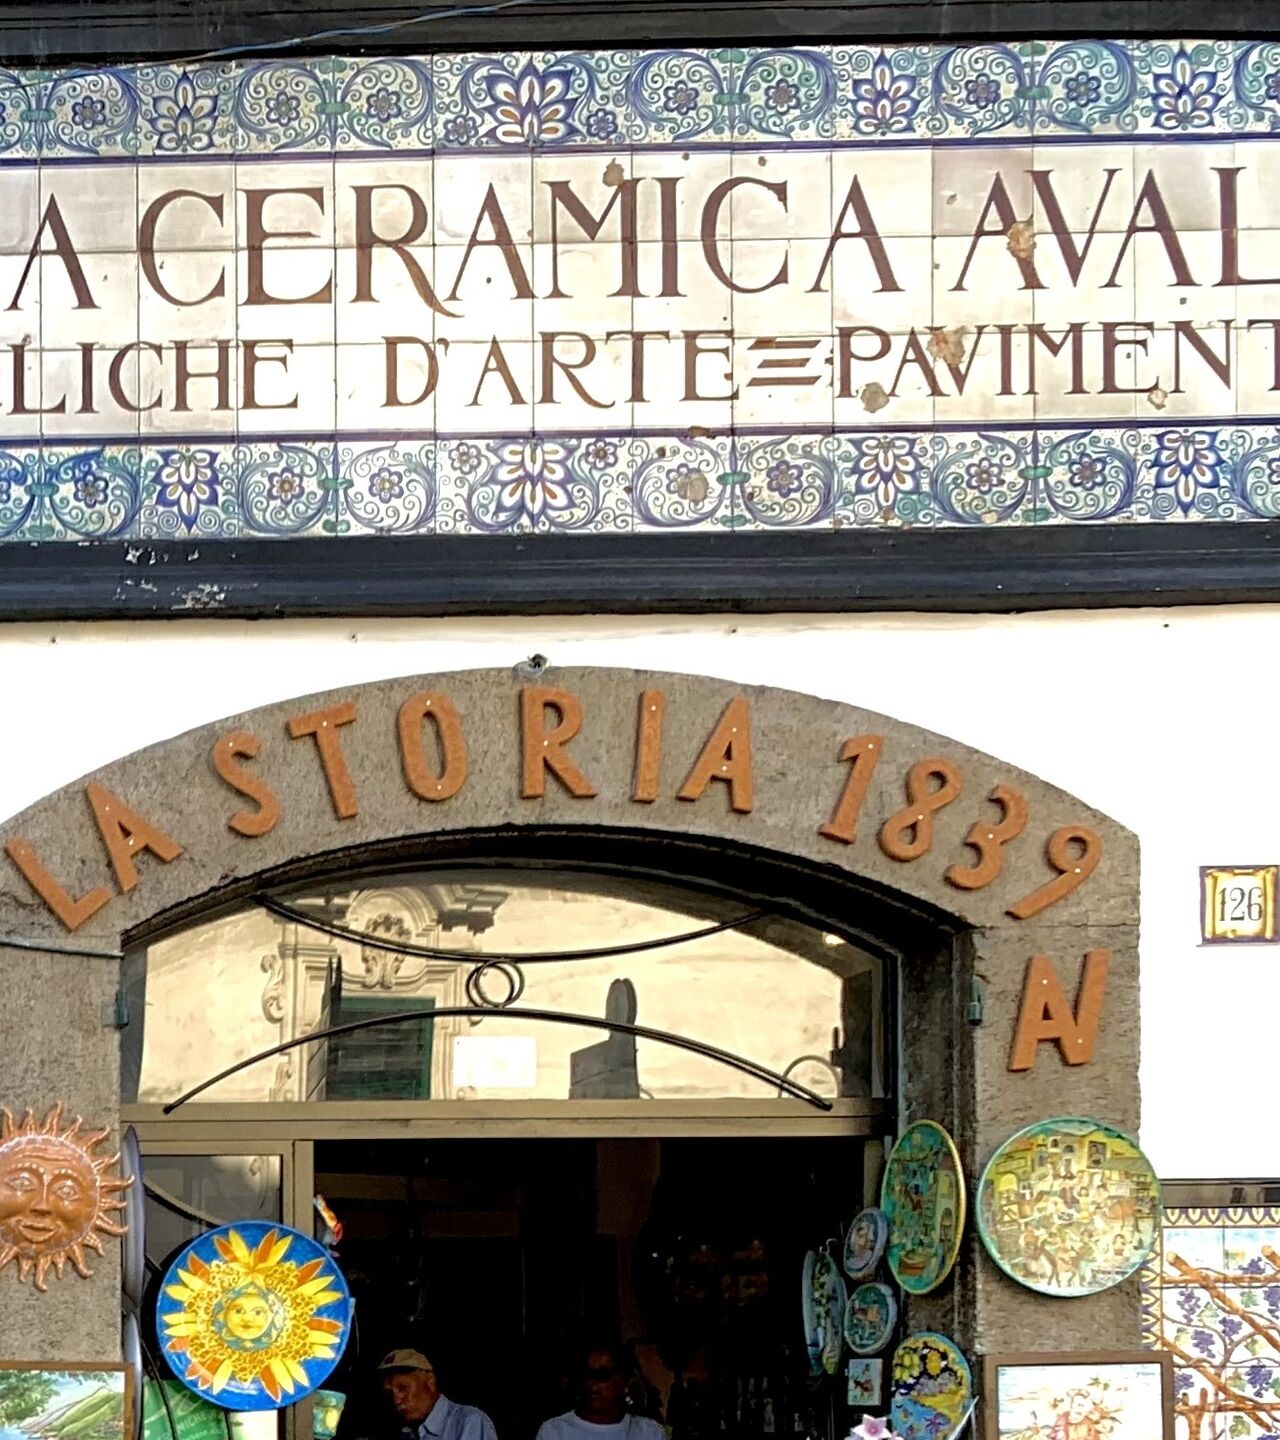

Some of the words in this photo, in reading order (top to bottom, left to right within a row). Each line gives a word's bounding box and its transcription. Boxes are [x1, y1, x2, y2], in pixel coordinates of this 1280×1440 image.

[137, 174, 908, 319] CERAMICA
[384, 329, 739, 410] D'ARTE
[4, 780, 184, 932] LA
[210, 688, 755, 840] STORIA
[816, 733, 1104, 922] 1839
[1218, 886, 1263, 922] 126
